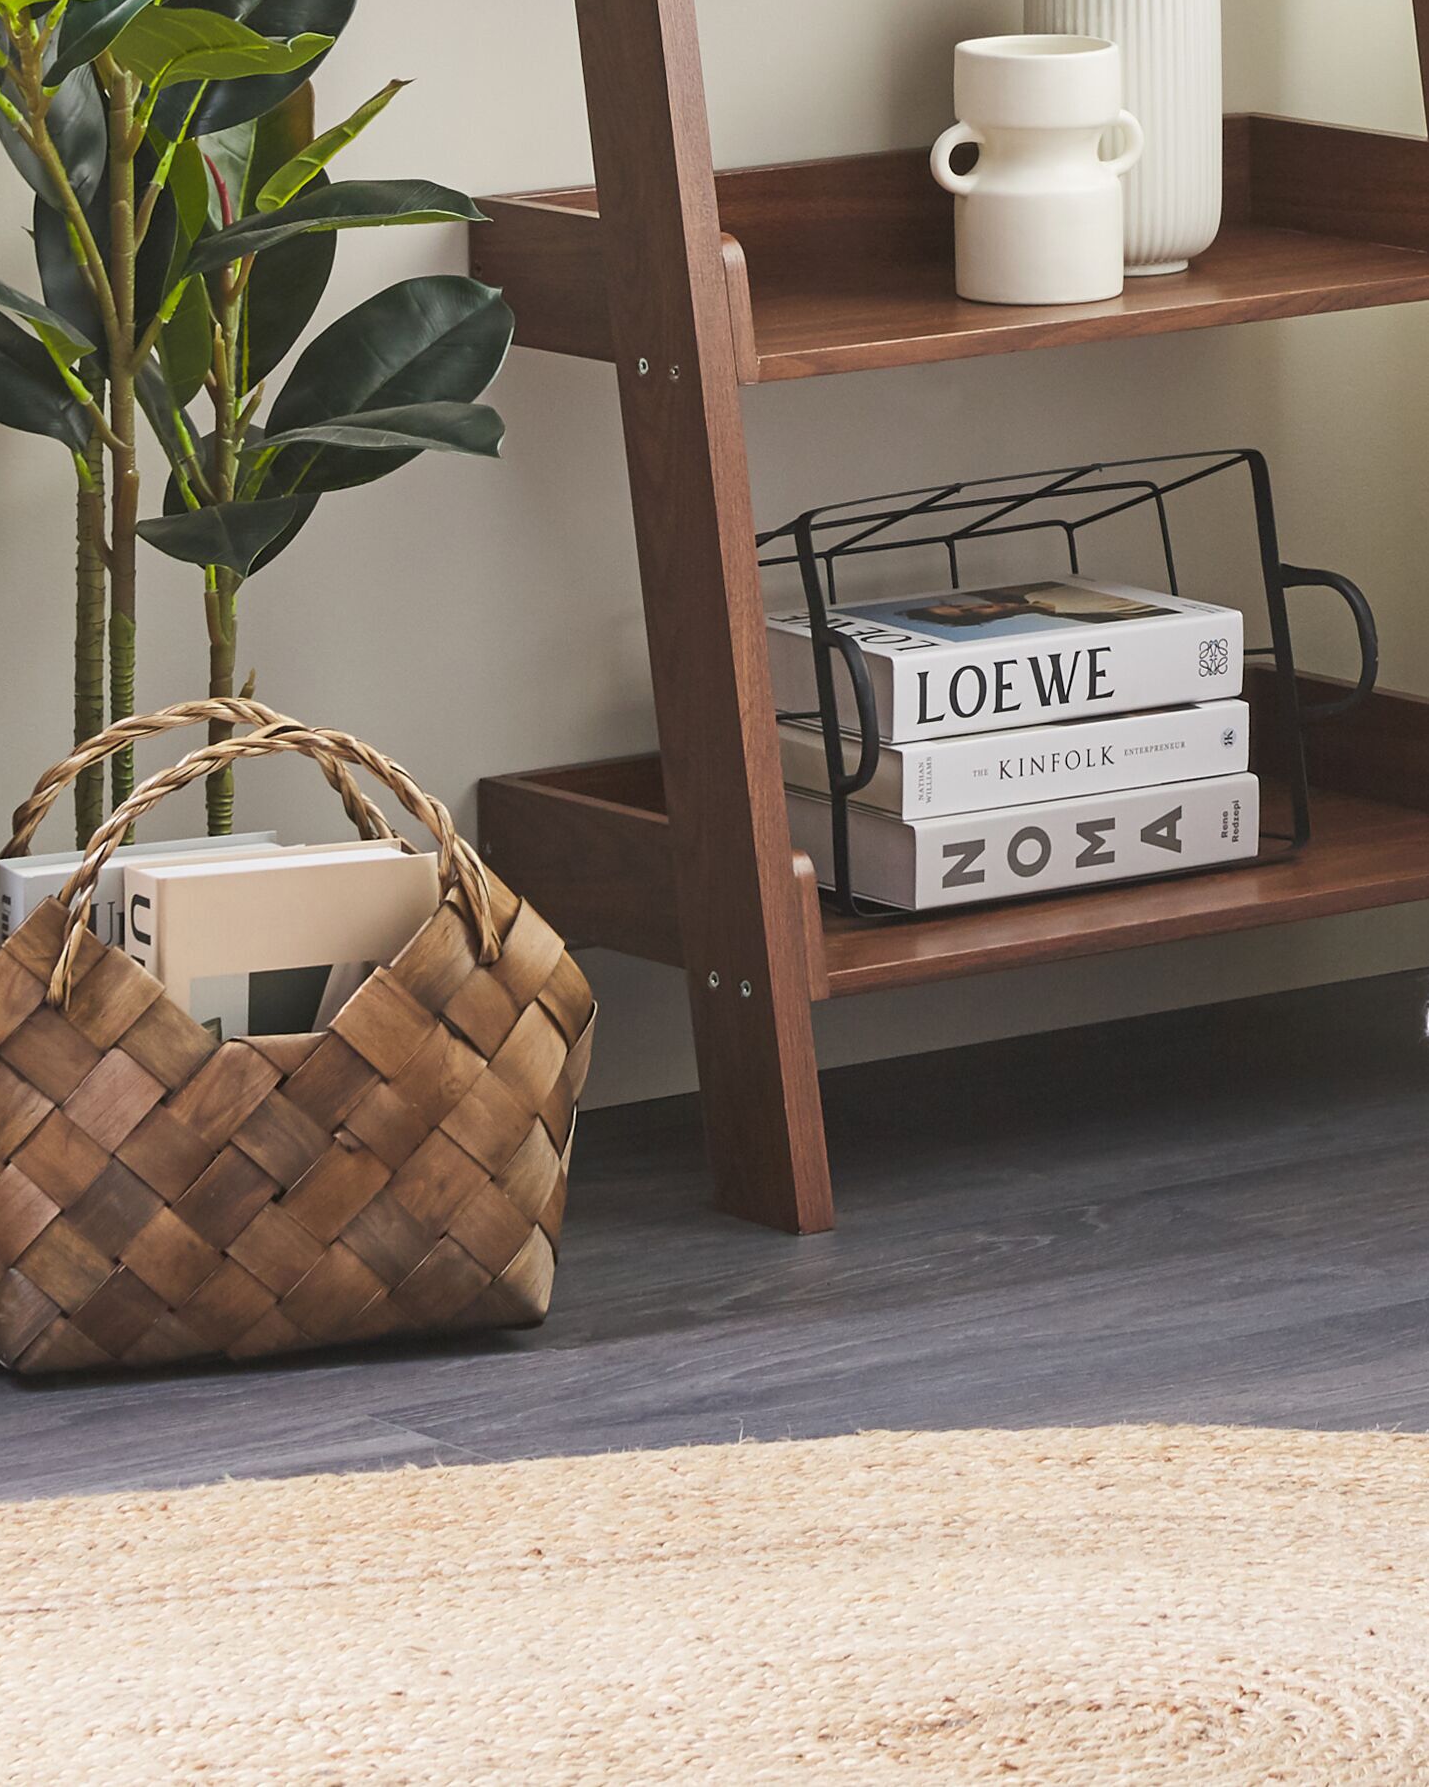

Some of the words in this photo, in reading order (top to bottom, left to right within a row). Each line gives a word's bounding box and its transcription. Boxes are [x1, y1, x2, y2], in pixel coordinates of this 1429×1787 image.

[917, 646, 1115, 725] LOEWE
[925, 756, 933, 804] WILLIAMS
[972, 768, 988, 777] THE
[998, 745, 1115, 780] KINFOLK
[942, 805, 1183, 889] NOMA
